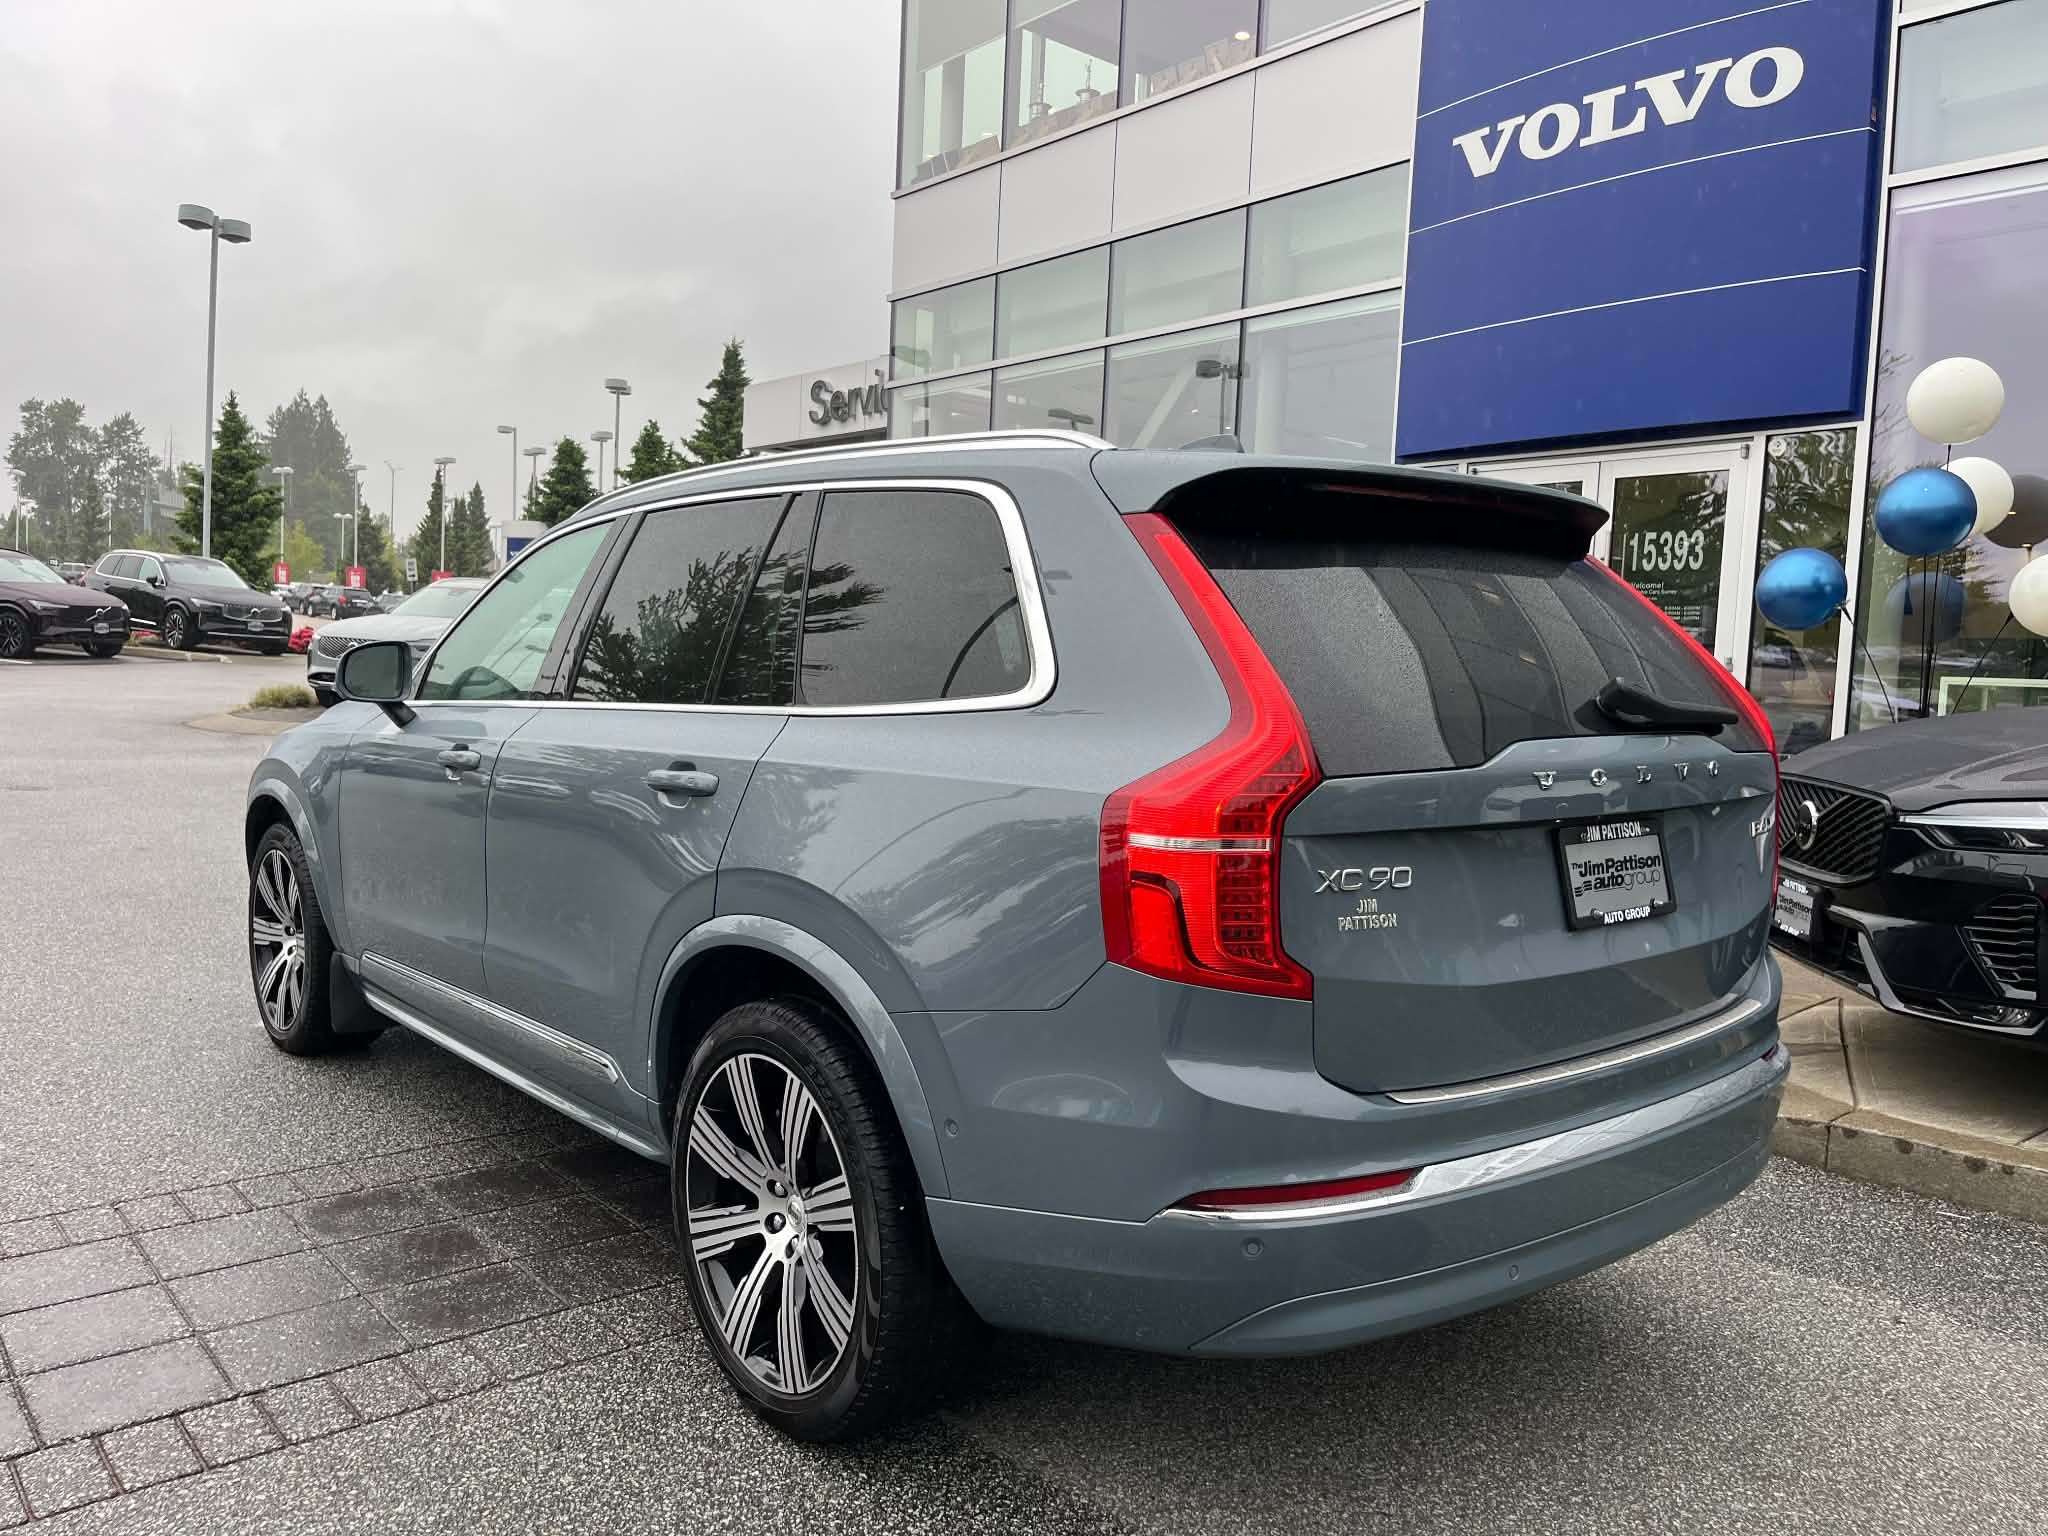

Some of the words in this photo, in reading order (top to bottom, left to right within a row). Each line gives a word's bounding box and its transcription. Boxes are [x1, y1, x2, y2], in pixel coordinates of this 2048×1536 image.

[1452, 46, 1804, 178] VOLVO
[808, 368, 889, 426] Servic
[1629, 529, 1705, 572] 15393
[1532, 759, 1720, 791] VOLVO
[1586, 825, 1601, 842] JIM
[1601, 820, 1642, 841] PATTISON
[1356, 898, 1378, 913] JIM
[1603, 910, 1624, 925] AUTO
[1624, 905, 1651, 921] GROUP
[1337, 912, 1398, 931] PATTISON
